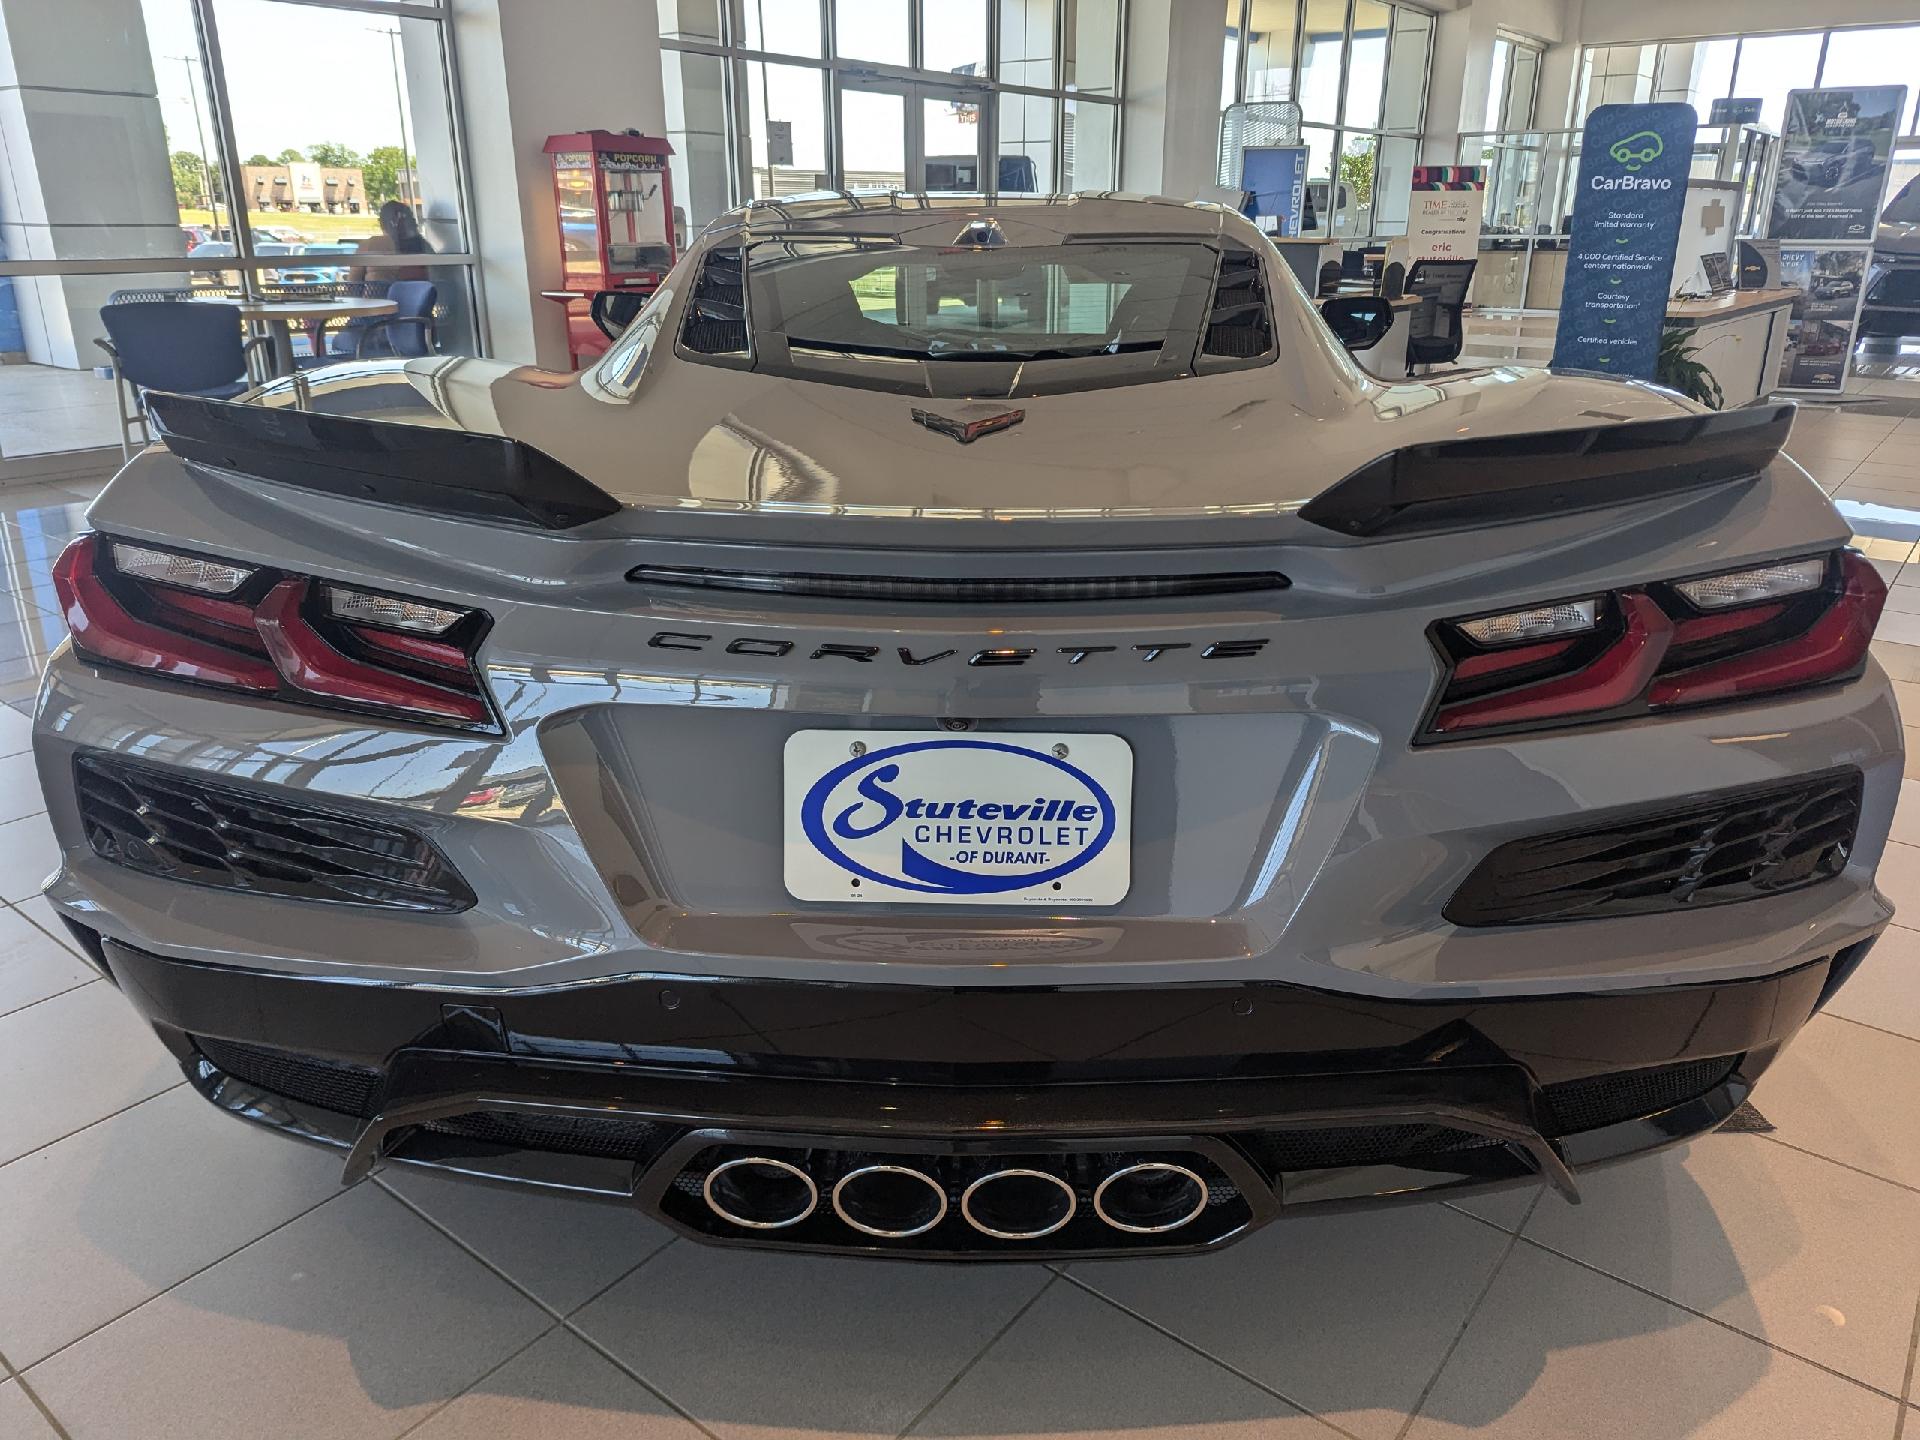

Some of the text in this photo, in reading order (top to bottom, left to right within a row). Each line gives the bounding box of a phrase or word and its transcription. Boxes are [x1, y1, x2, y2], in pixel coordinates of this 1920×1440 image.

[614, 153, 657, 164] POPCORN
[1591, 175, 1672, 190] CarBravo
[1288, 153, 1304, 237] HEVROLET
[1423, 200, 1448, 209] TIME
[1608, 211, 1644, 219] Standard
[1594, 220, 1619, 228] limited
[1431, 242, 1452, 251] eric
[1602, 253, 1635, 261] Certified
[1635, 254, 1663, 262] Service
[1597, 292, 1630, 302] Courtesy
[1577, 336, 1608, 344] Certified
[647, 631, 1271, 666] CORVETTE
[833, 764, 1098, 839] Stuteville
[915, 824, 1090, 846] CHEVROLET
